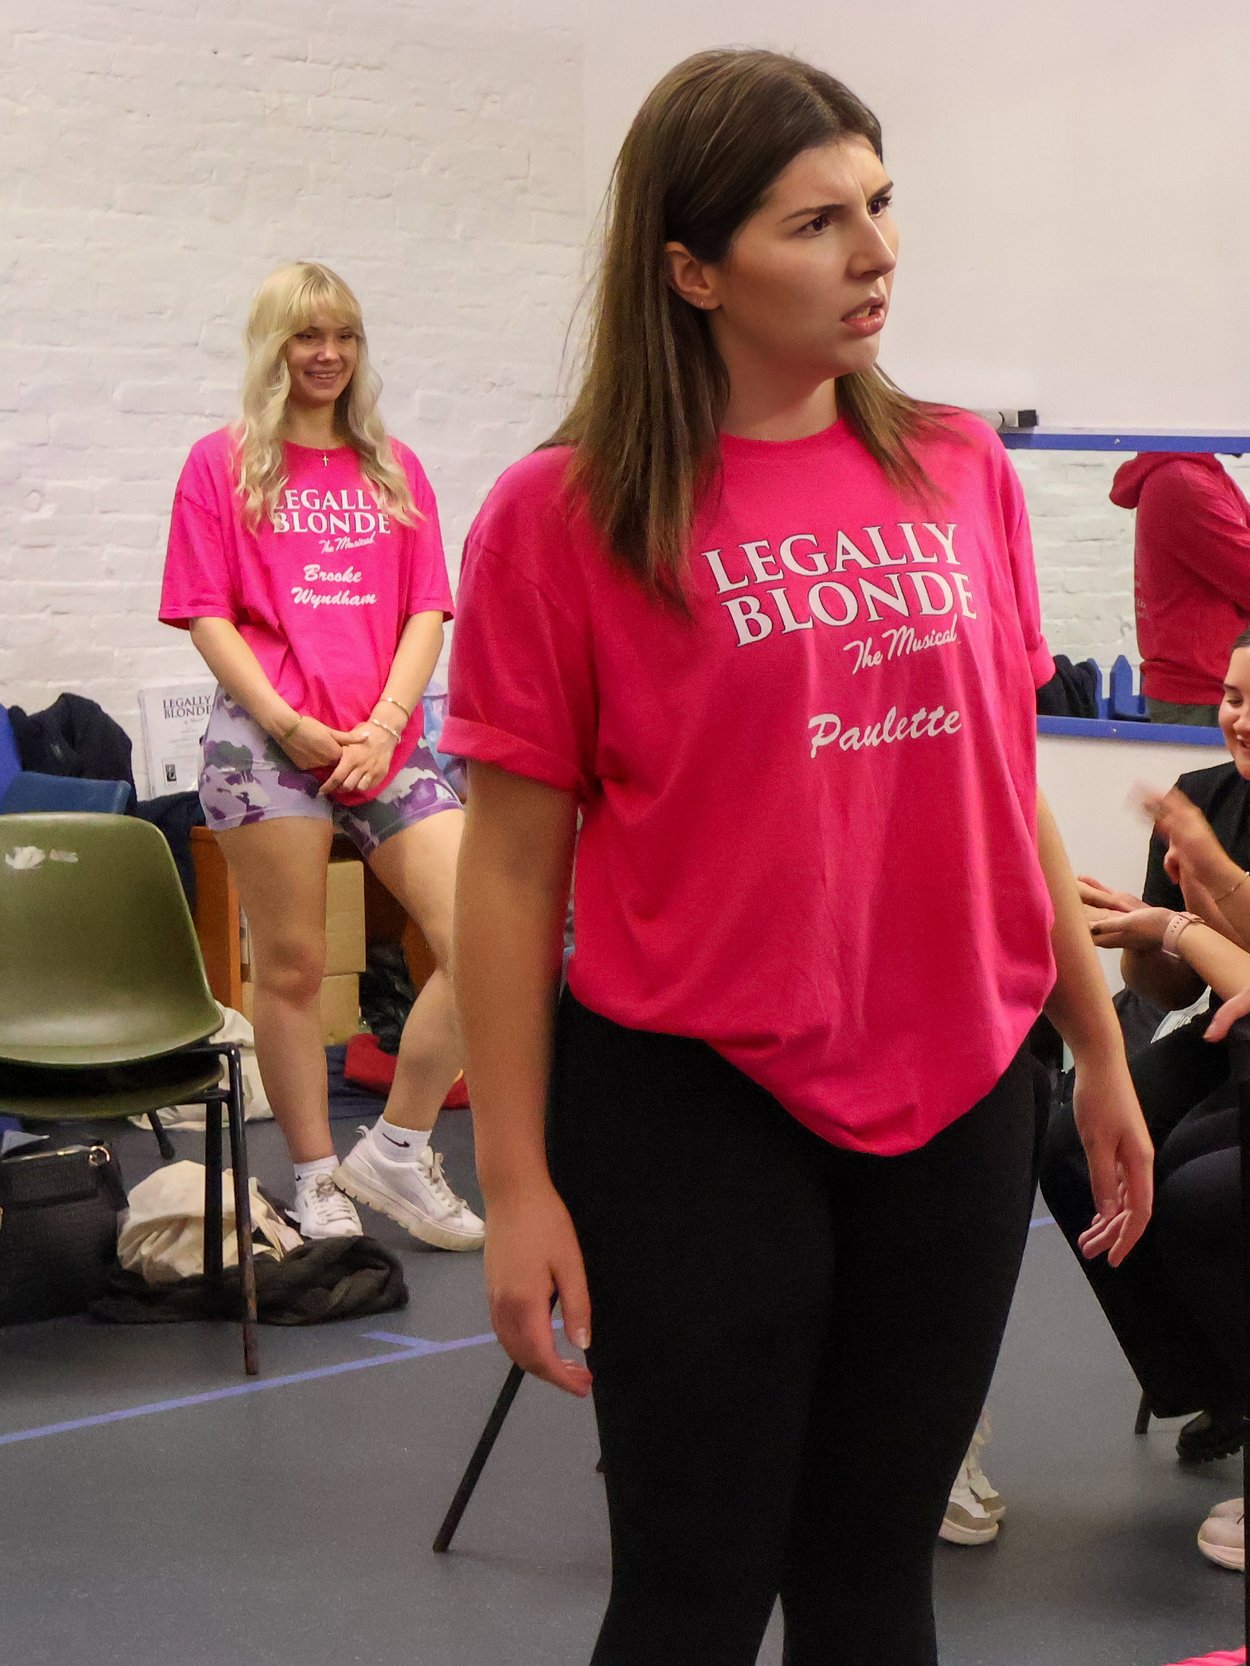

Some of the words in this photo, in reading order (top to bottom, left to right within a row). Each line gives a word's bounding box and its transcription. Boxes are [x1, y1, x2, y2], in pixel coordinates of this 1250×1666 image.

[273, 511, 391, 534] BLONDE
[319, 539, 335, 554] The
[335, 531, 377, 550] Musical
[701, 523, 960, 595] LEGALLY
[303, 564, 362, 583] Brooke
[291, 586, 377, 609] Wyndham
[721, 571, 977, 647] BLONDE
[843, 637, 882, 675] The
[882, 614, 958, 661] Musical
[163, 696, 211, 709] LEGALLY
[808, 705, 962, 758] Paulette
